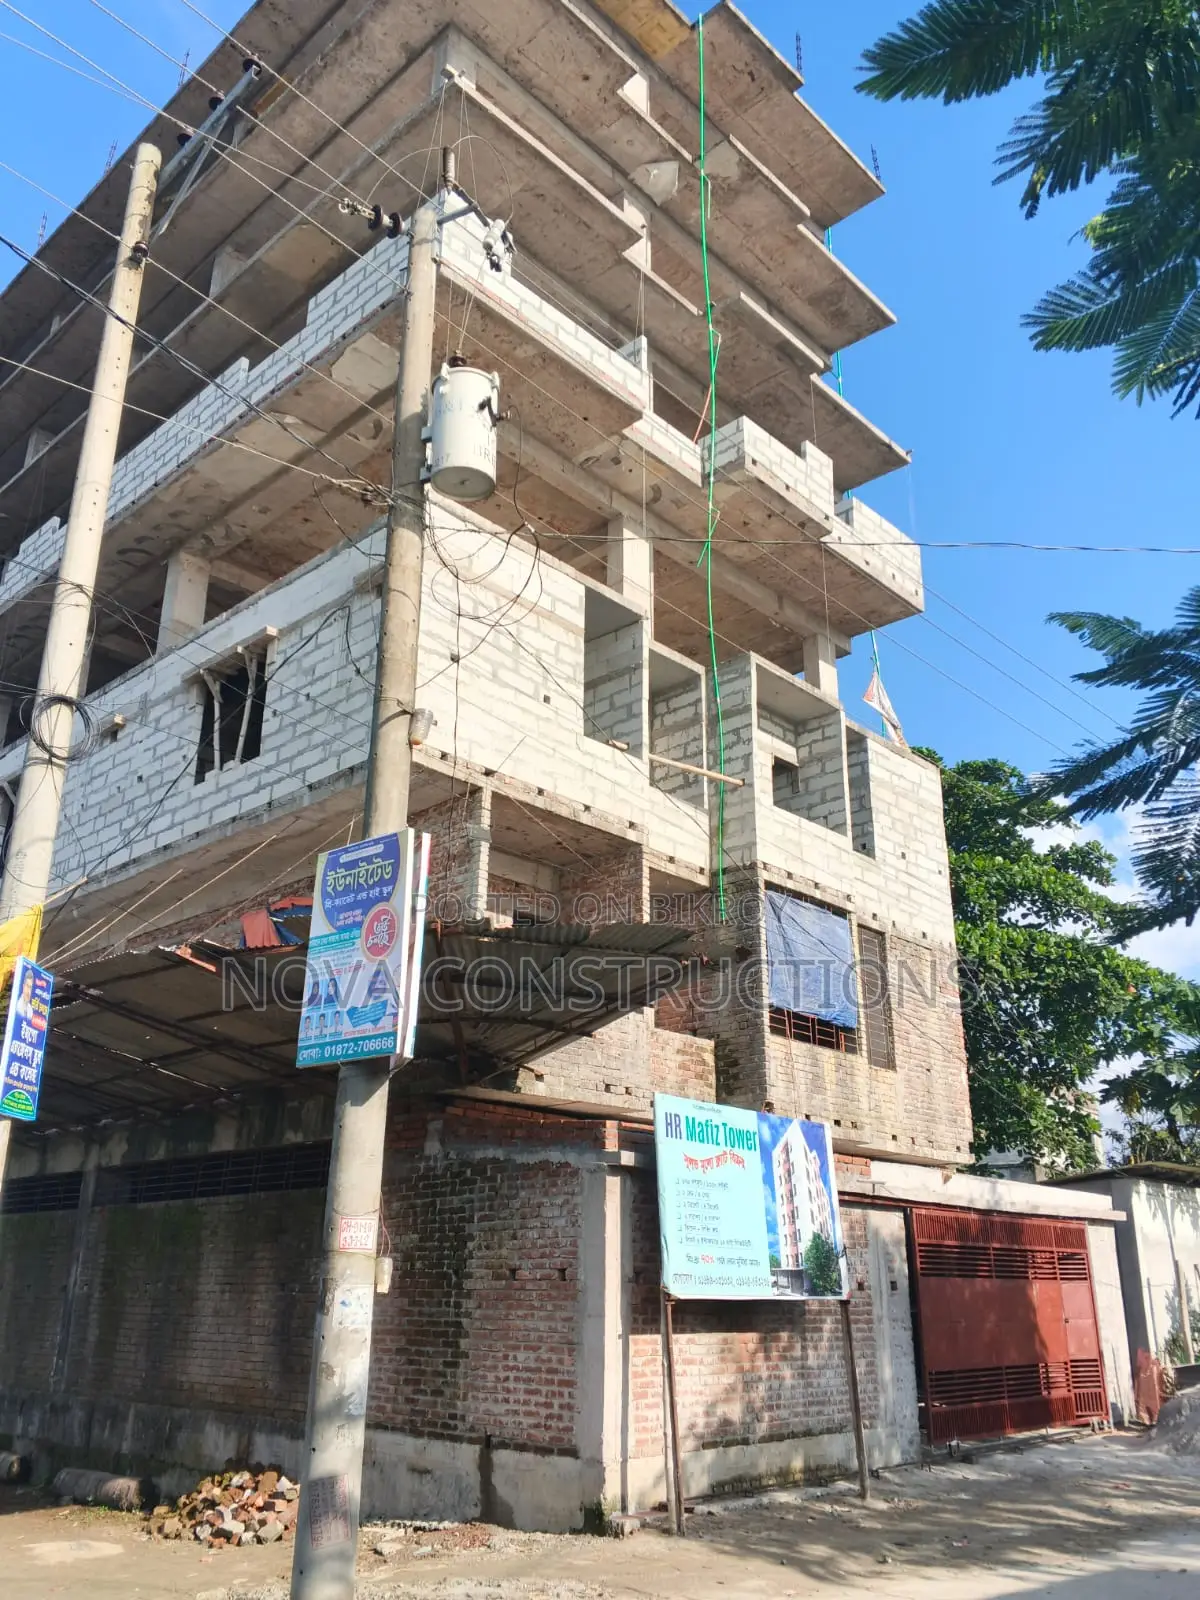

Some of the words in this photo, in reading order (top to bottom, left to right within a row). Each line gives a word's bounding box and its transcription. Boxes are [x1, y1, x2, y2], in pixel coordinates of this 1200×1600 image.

[326, 857, 395, 896] ইউনাইটেড
[324, 1036, 394, 1058] 01872-706666
[665, 1112, 682, 1140] HR
[685, 1115, 720, 1147] Mafiz
[722, 1122, 757, 1152] Tower
